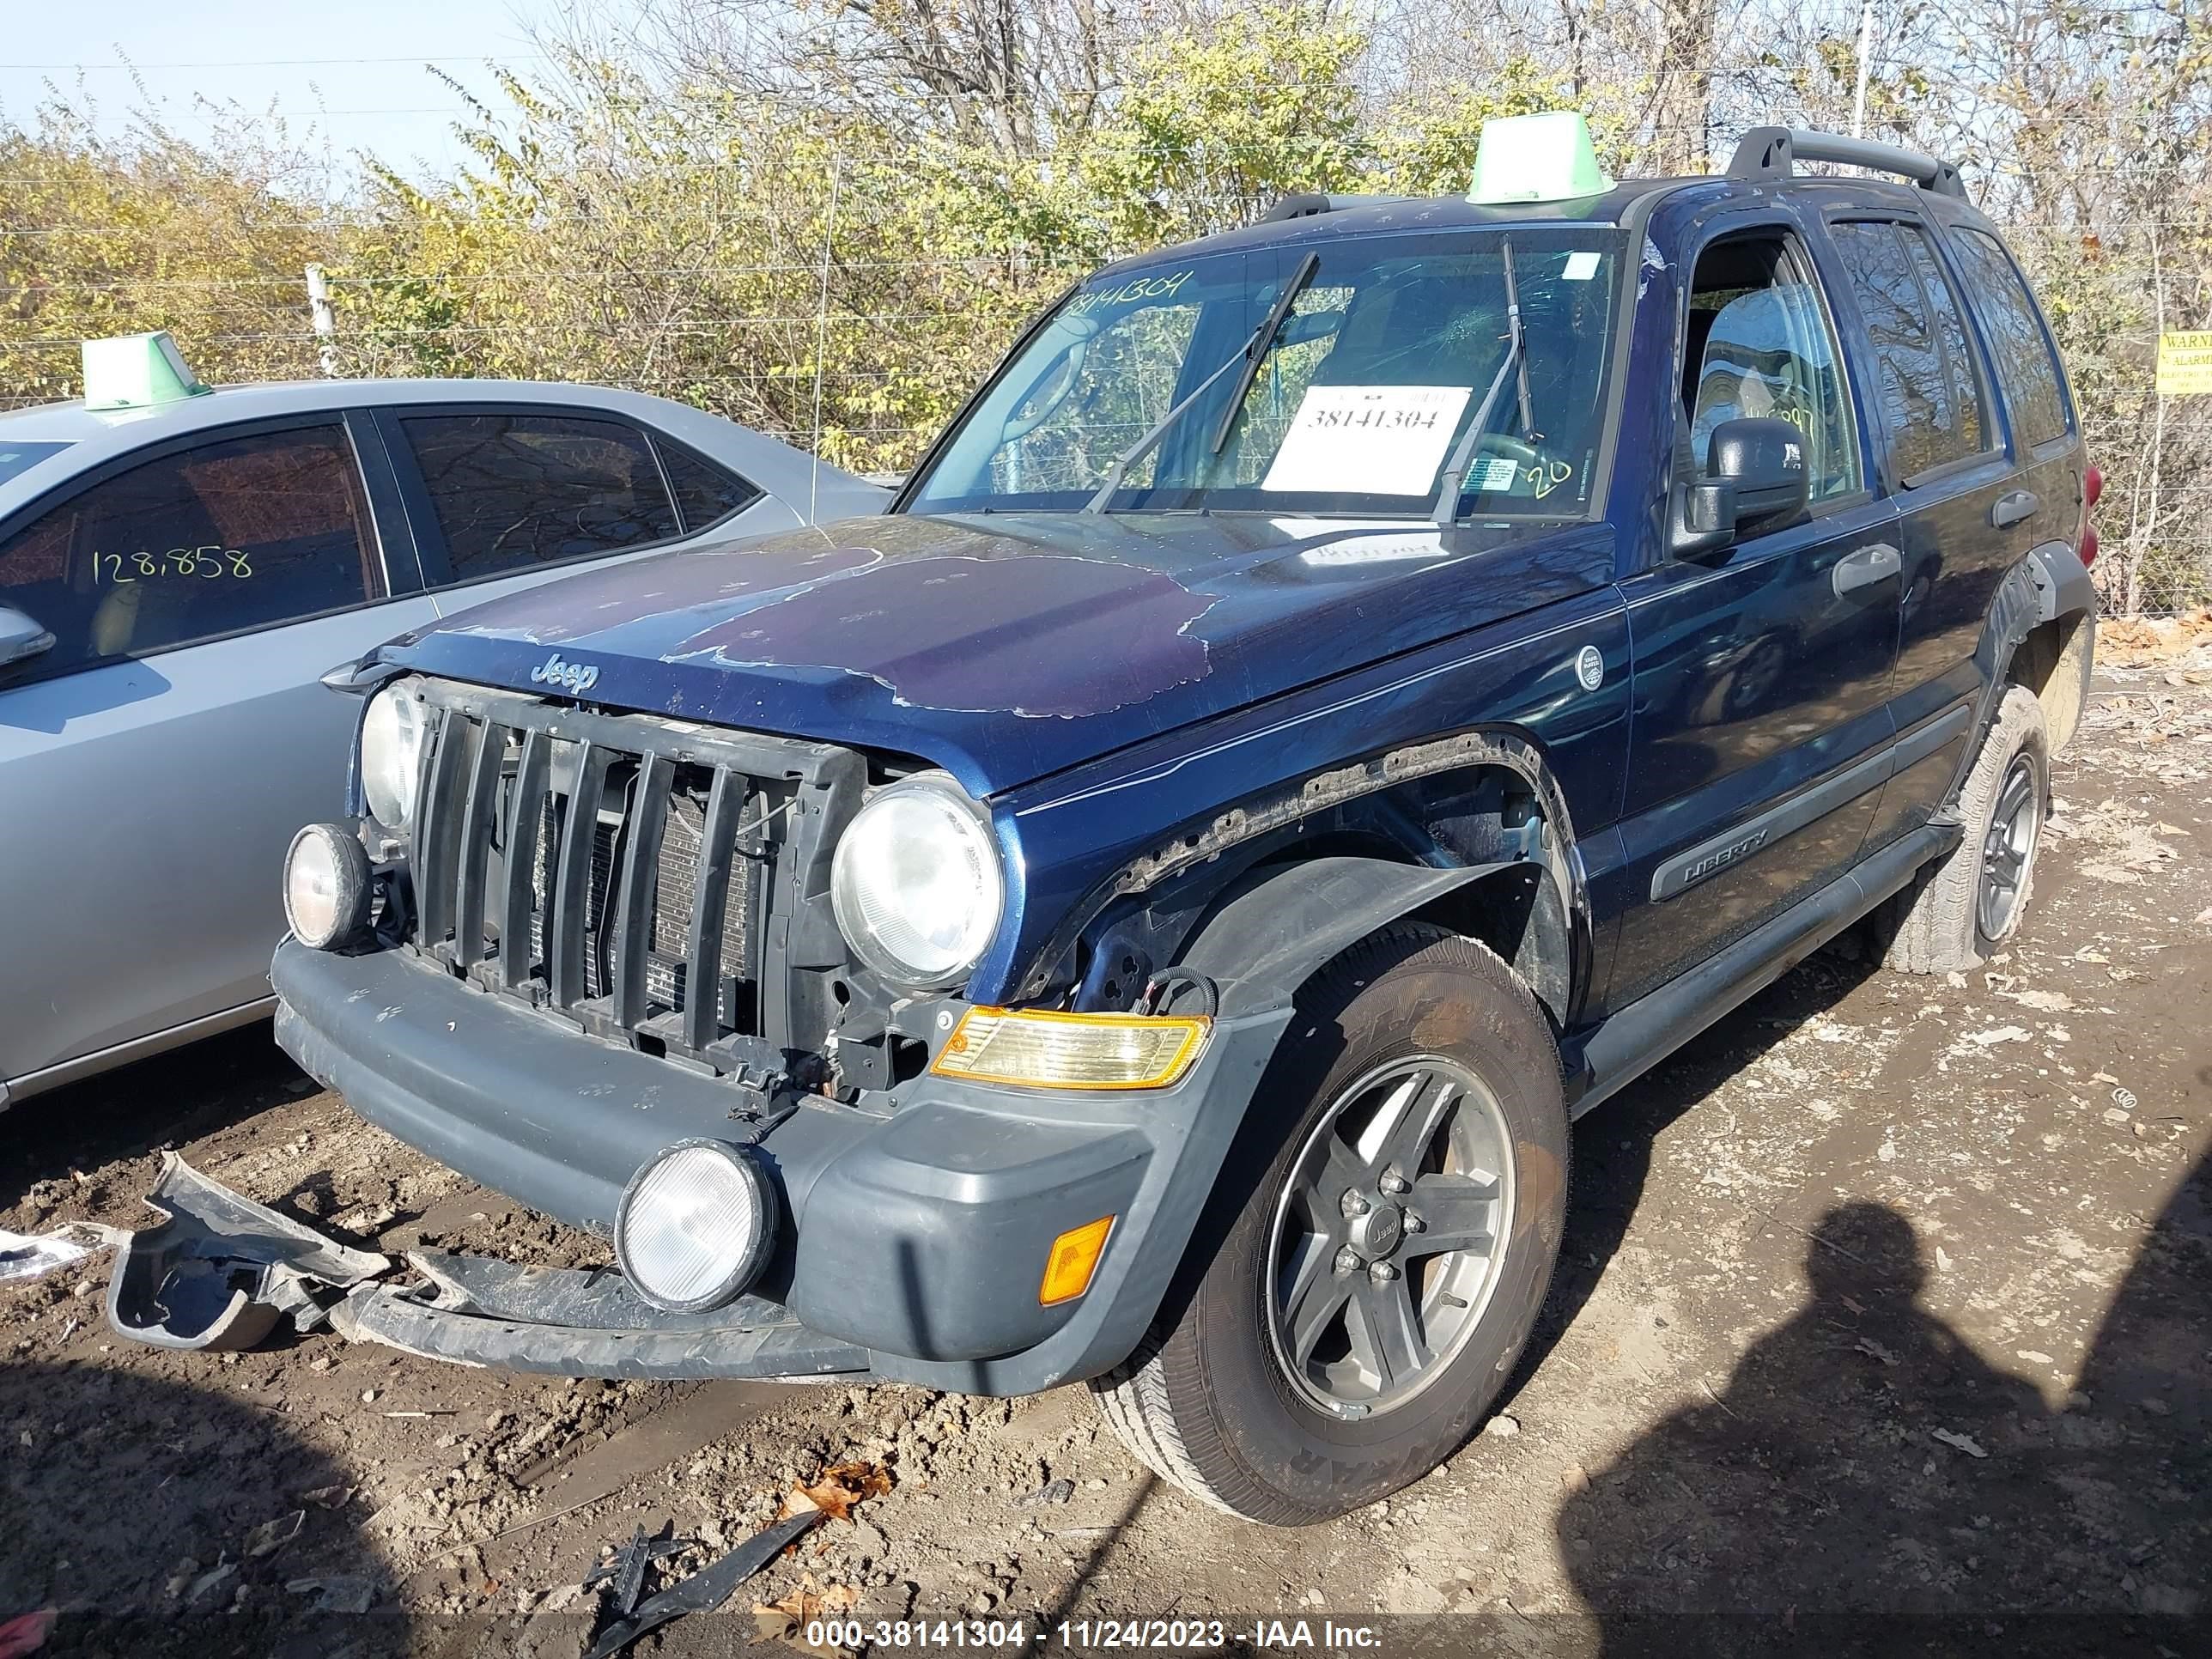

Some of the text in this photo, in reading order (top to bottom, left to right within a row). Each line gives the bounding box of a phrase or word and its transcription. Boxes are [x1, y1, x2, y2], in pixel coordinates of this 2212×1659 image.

[1308, 410, 1438, 428] 38141304
[1527, 461, 1572, 500] 20
[530, 653, 600, 696] Jeep
[1684, 828, 1769, 883] LIBERTY
[1373, 1218, 1398, 1244] Jeep
